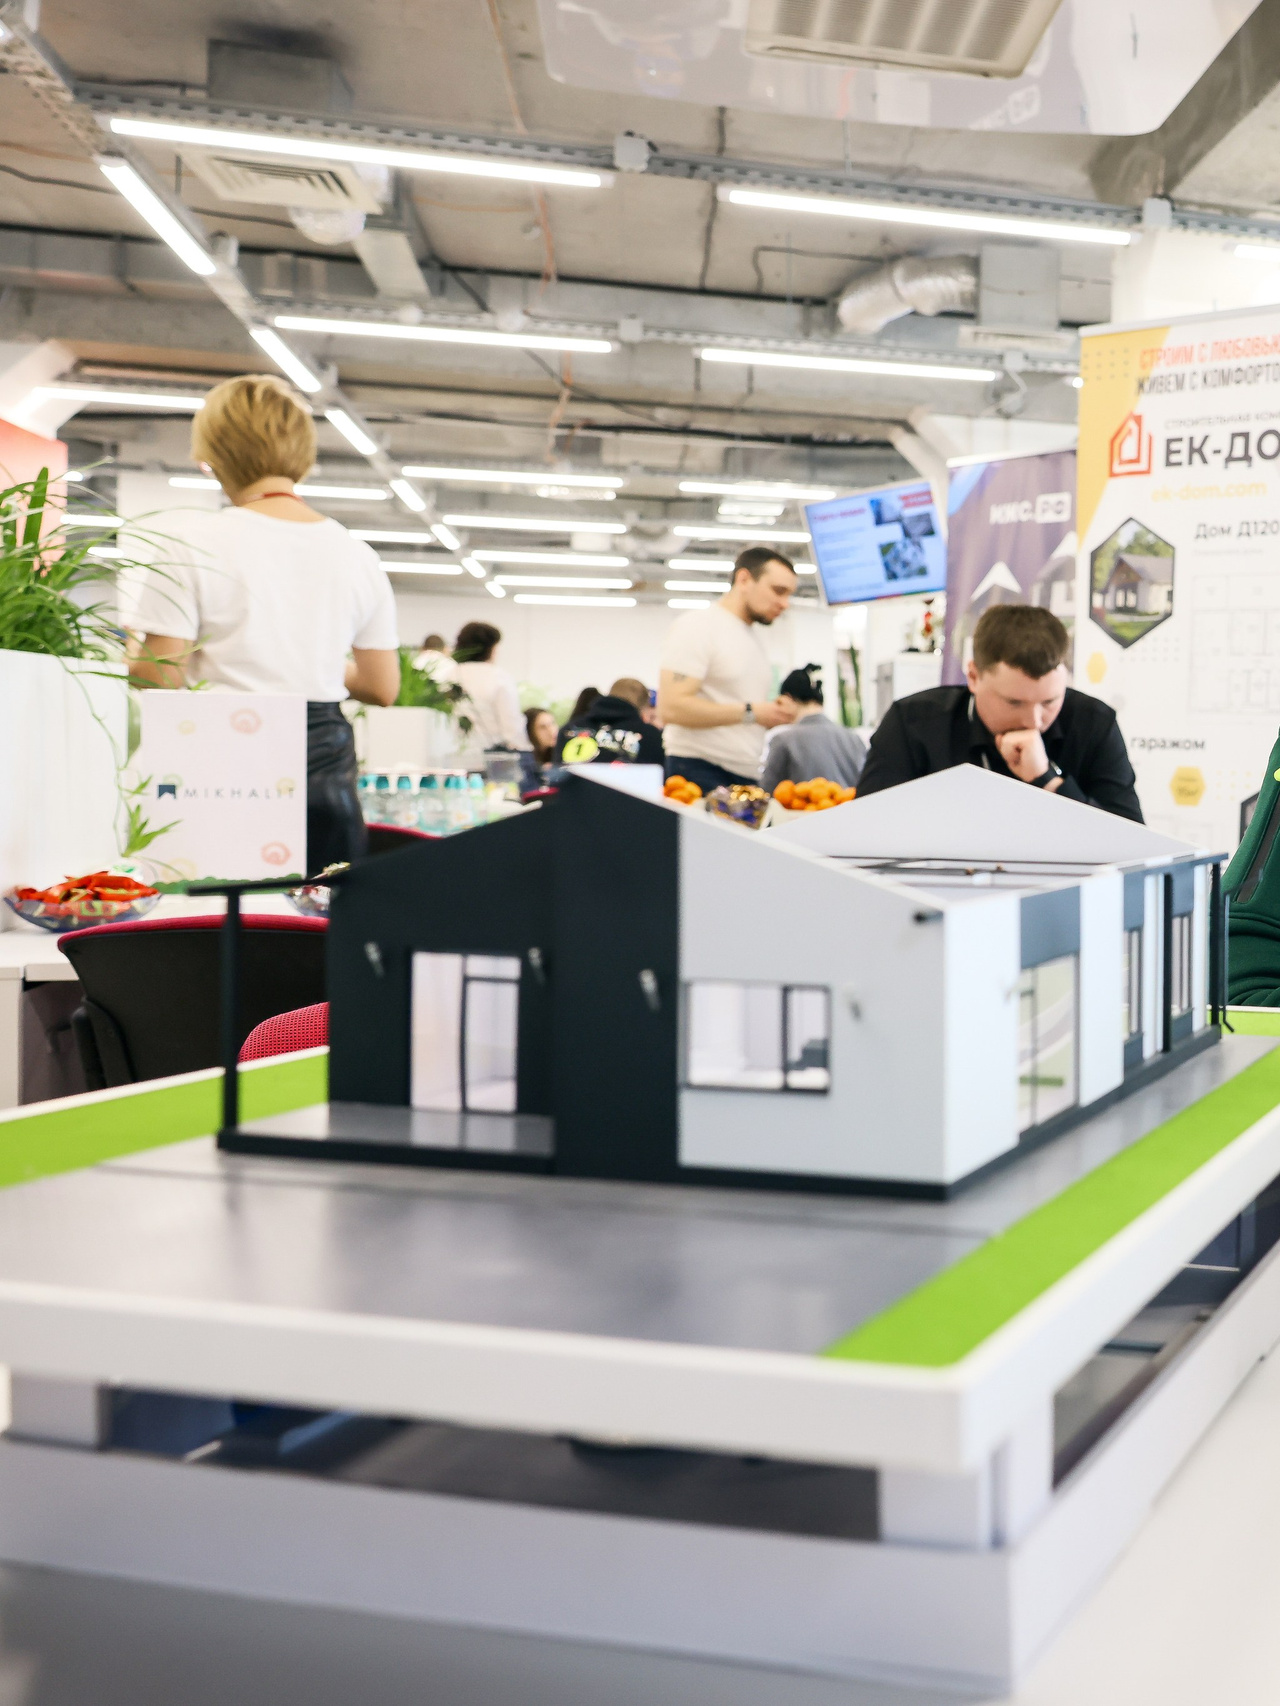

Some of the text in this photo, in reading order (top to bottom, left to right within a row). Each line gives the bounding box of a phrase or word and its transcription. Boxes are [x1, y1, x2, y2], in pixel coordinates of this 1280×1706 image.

[1152, 481, 1268, 502] ek-dom.com
[1194, 519, 1280, 540] Дом Д120
[1130, 736, 1207, 753] гаражом
[183, 787, 295, 801] MIKHALIT
